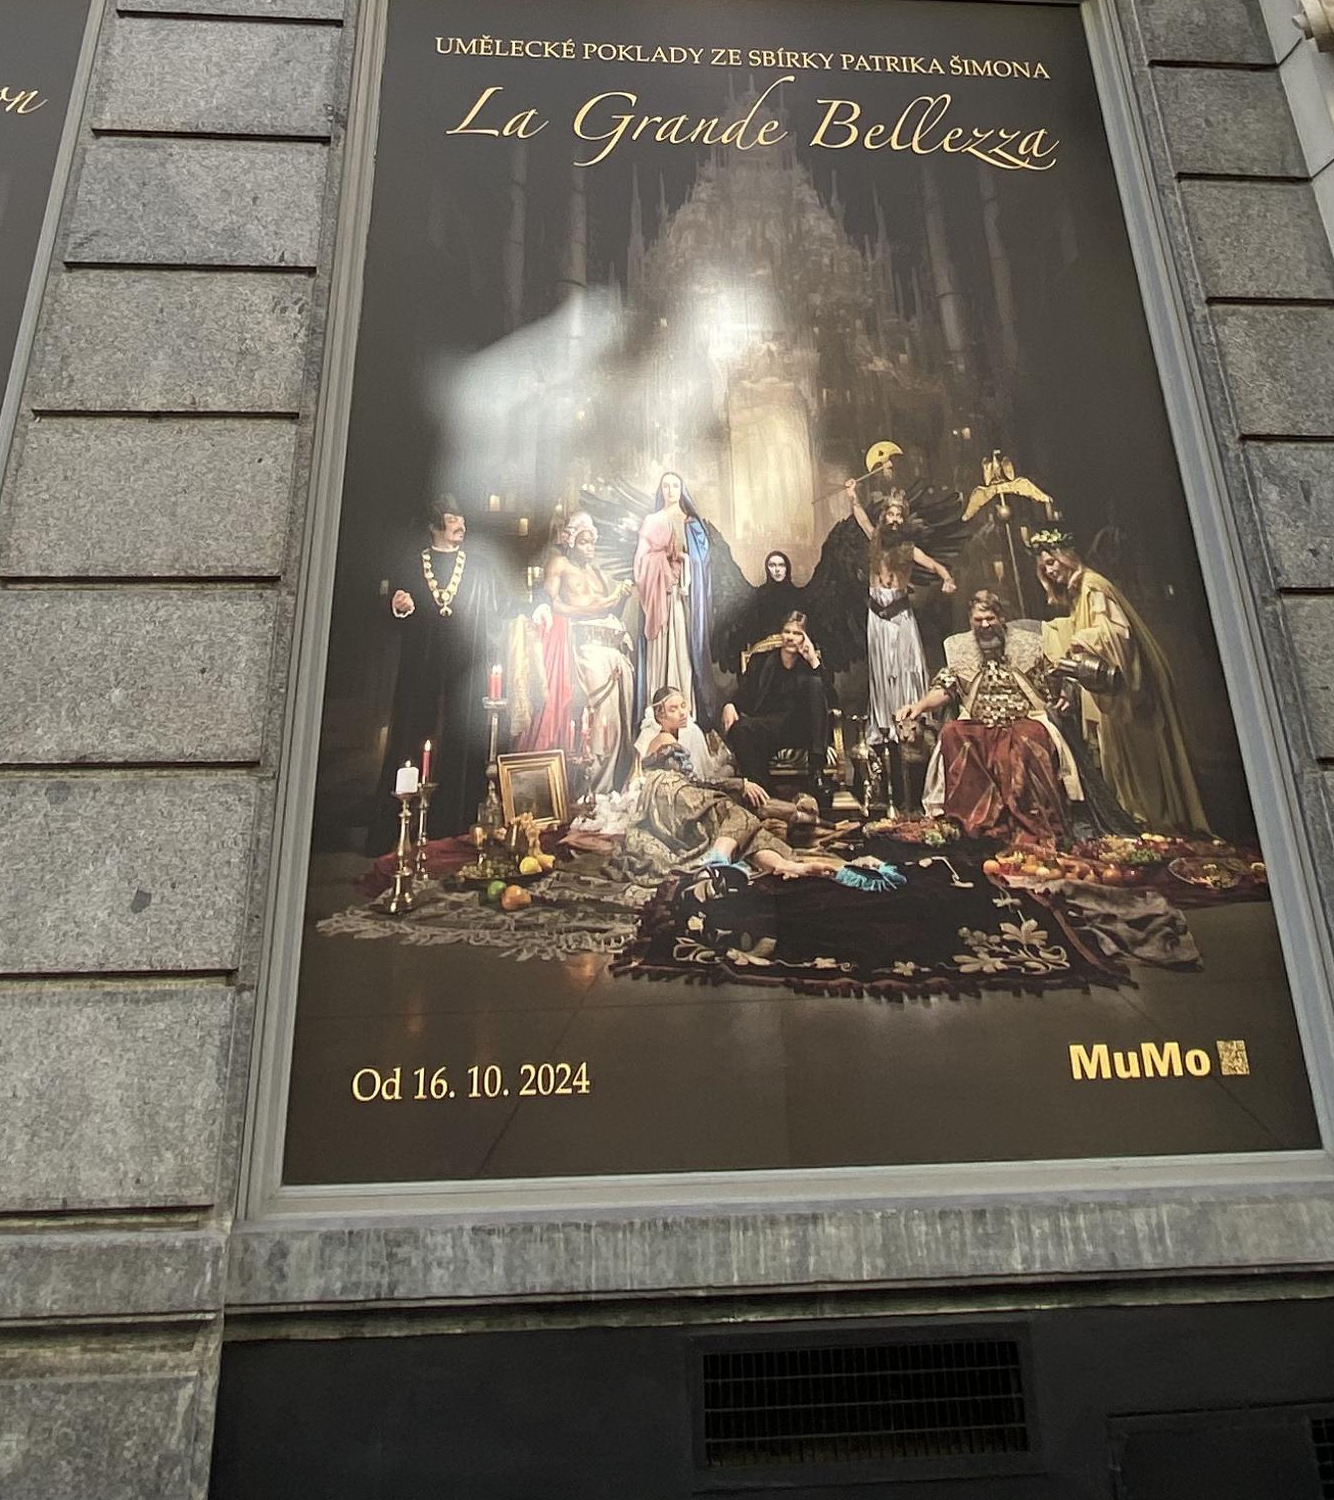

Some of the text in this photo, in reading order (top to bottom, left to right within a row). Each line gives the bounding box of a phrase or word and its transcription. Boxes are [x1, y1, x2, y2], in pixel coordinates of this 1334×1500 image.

[435, 34, 1051, 80] UMĚLECKÉ POKLADY ZE SBÍRKY PATRIKA ŠIMONA
[445, 75, 1061, 172] La Grande Bellezza
[352, 1061, 590, 1101] Od 16. 10. 2024
[1069, 1042, 1212, 1080] MuMo
